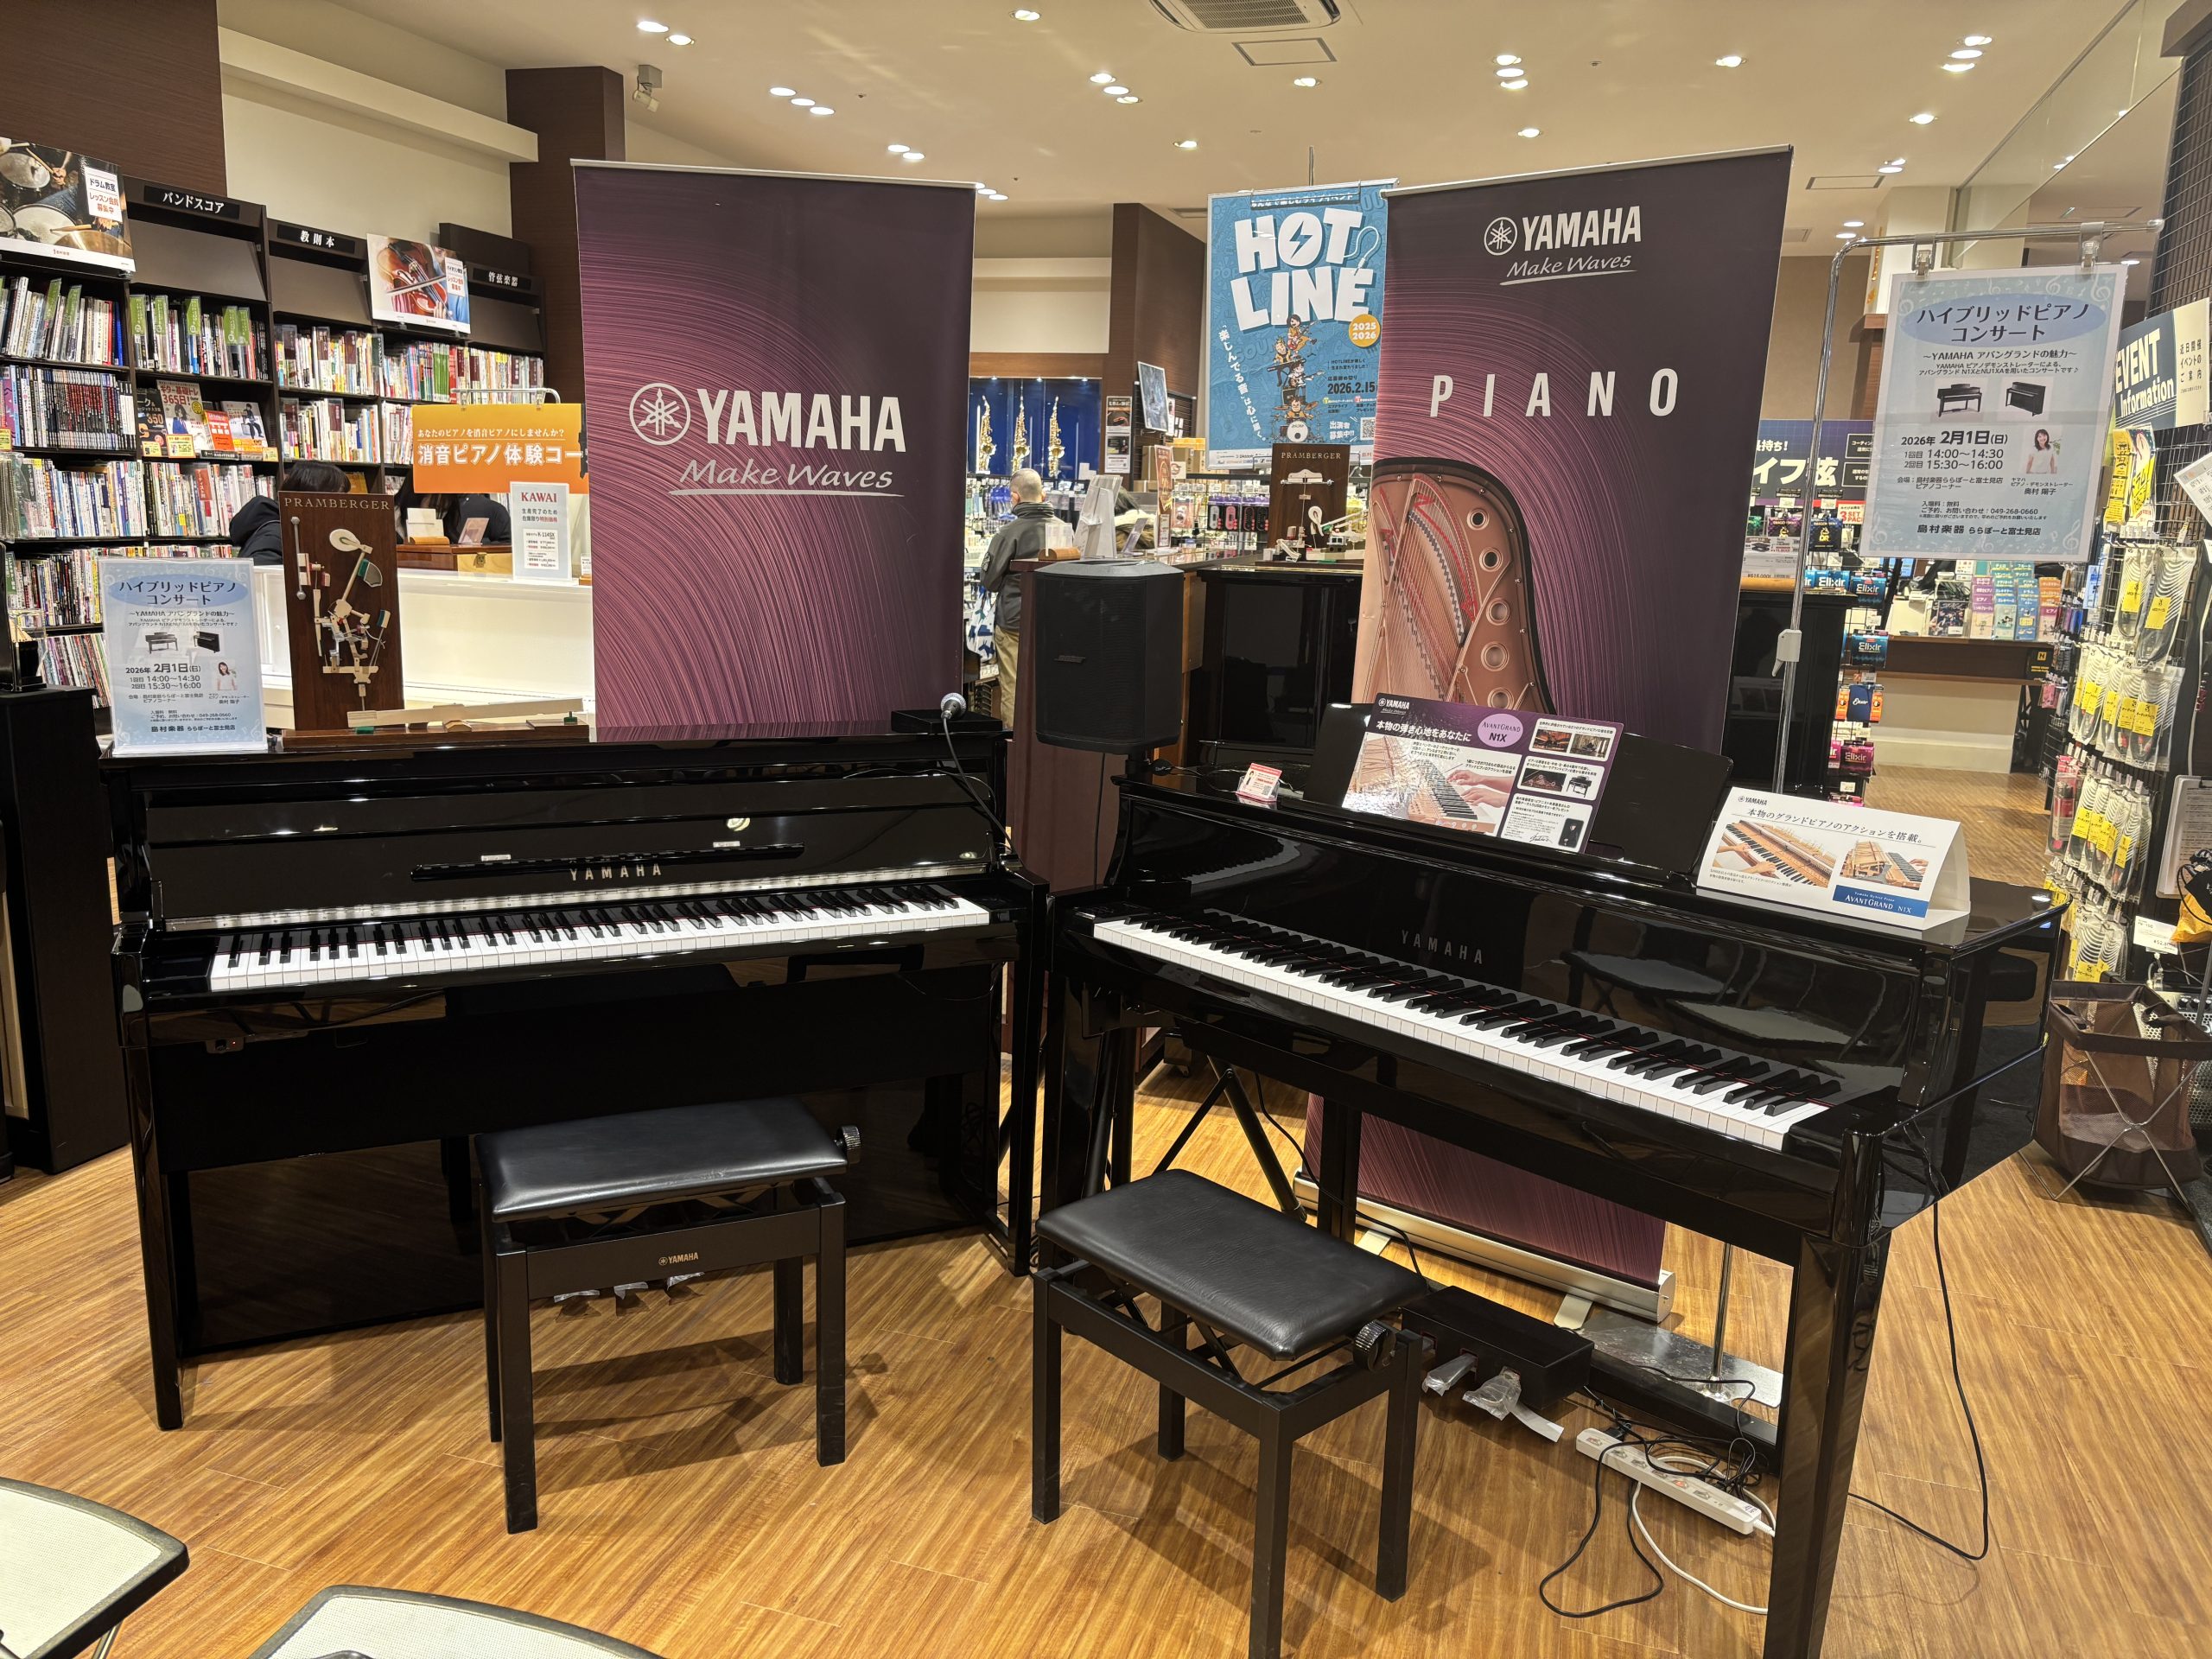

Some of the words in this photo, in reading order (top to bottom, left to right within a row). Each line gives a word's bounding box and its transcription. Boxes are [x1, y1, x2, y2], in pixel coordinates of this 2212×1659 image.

[89, 178, 117, 193] ドラム教室
[89, 192, 119, 207] レッスン会員
[162, 191, 225, 214] バンドスコア
[1522, 205, 1642, 251] YAMAHA
[300, 230, 335, 249] 教則本
[1234, 207, 1363, 273] HOT
[1507, 257, 1563, 278] Make
[1567, 255, 1631, 272] Waves
[488, 270, 518, 288] 管弦楽器
[1230, 266, 1374, 331] LINE
[1916, 303, 2090, 324] ハイブリッドピアノ
[1352, 331, 1376, 340] 2026
[1951, 325, 2045, 342] コンサート
[2116, 328, 2160, 394] EVENT
[2181, 354, 2202, 369] イベントの
[1430, 368, 1679, 417] PIANO
[2120, 376, 2174, 417] Information
[696, 388, 906, 453] YAMAHA
[1901, 435, 1936, 446] 2026年
[418, 443, 588, 466] 消音ピアノ体験コー
[1904, 450, 1923, 459] 1回目
[1904, 461, 1923, 469] 2回目
[679, 459, 779, 485] Make
[786, 464, 893, 488] Waves
[284, 498, 390, 510] PRAMBERGER
[521, 493, 557, 503] KAWAI
[1916, 524, 1965, 534] 島村楽器
[1968, 527, 2041, 536] ららぽーと富士見店
[119, 581, 237, 593] ハイブリッドピアノ
[1819, 577, 1846, 587] Elixir
[1856, 583, 1879, 594] Elixir
[147, 594, 212, 606] コンサート
[1859, 642, 1881, 652] Elixir
[1385, 699, 1410, 710] YAMAHA
[1376, 720, 1471, 742] 本物の弾き心地をあなたに
[1489, 732, 1507, 742] N1X
[1845, 753, 1866, 761] Elixir
[1745, 797, 1767, 806] YAMAHA
[1747, 808, 1923, 844] 本物のグランドピアノのアクションを搭載。
[569, 863, 662, 881] YAMAHA
[1402, 929, 1483, 964] YAMAHA
[668, 1252, 699, 1264] YAMAHA
